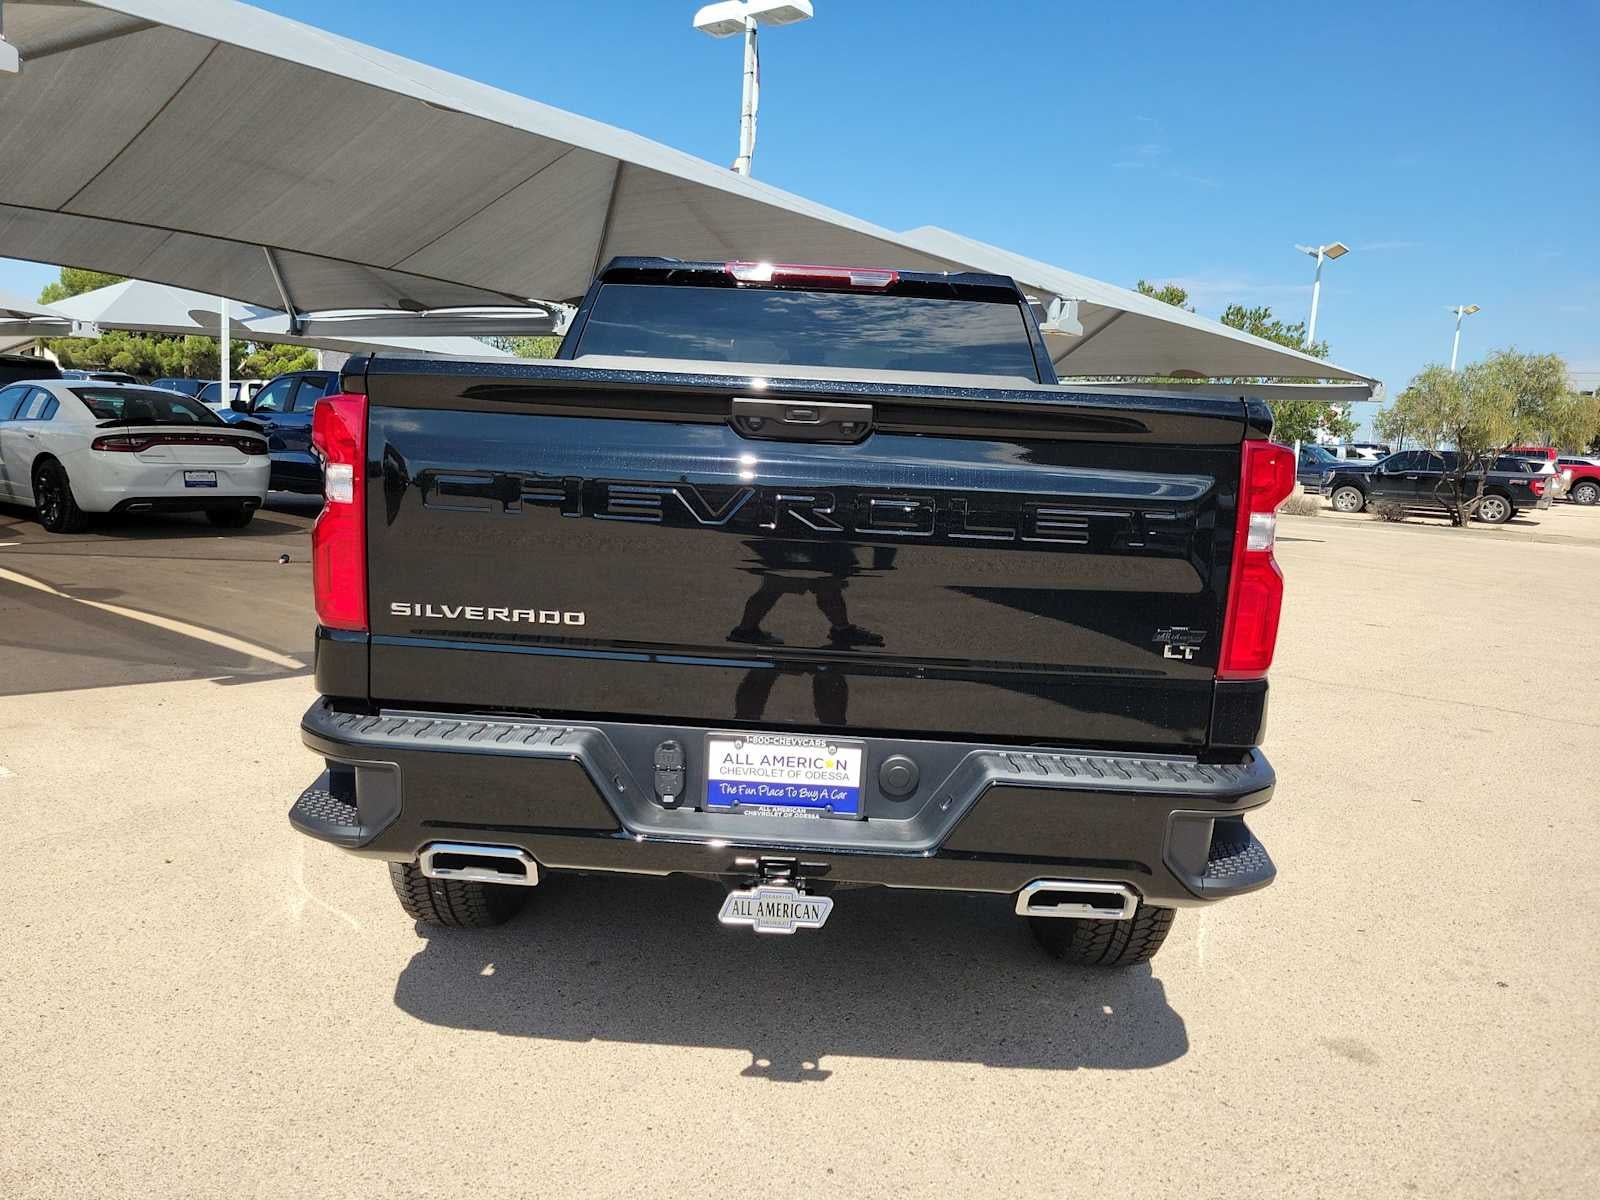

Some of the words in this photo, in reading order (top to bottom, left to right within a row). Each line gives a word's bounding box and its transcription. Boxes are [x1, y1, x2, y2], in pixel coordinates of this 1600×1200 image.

[390, 602, 587, 626] SILVERADO
[1163, 644, 1201, 660] LT
[722, 752, 755, 766] ALL
[719, 765, 785, 778] CHEVROLET
[787, 769, 802, 780] OF
[805, 770, 850, 782] ODESSA
[720, 782, 737, 795] The
[738, 783, 757, 796] Fun
[758, 784, 785, 797] Place
[785, 786, 798, 798] To
[798, 787, 819, 802] Buy
[820, 788, 829, 800] A
[830, 789, 848, 801] Car
[732, 900, 753, 917] ALL
[756, 901, 820, 921] AMERICAN
